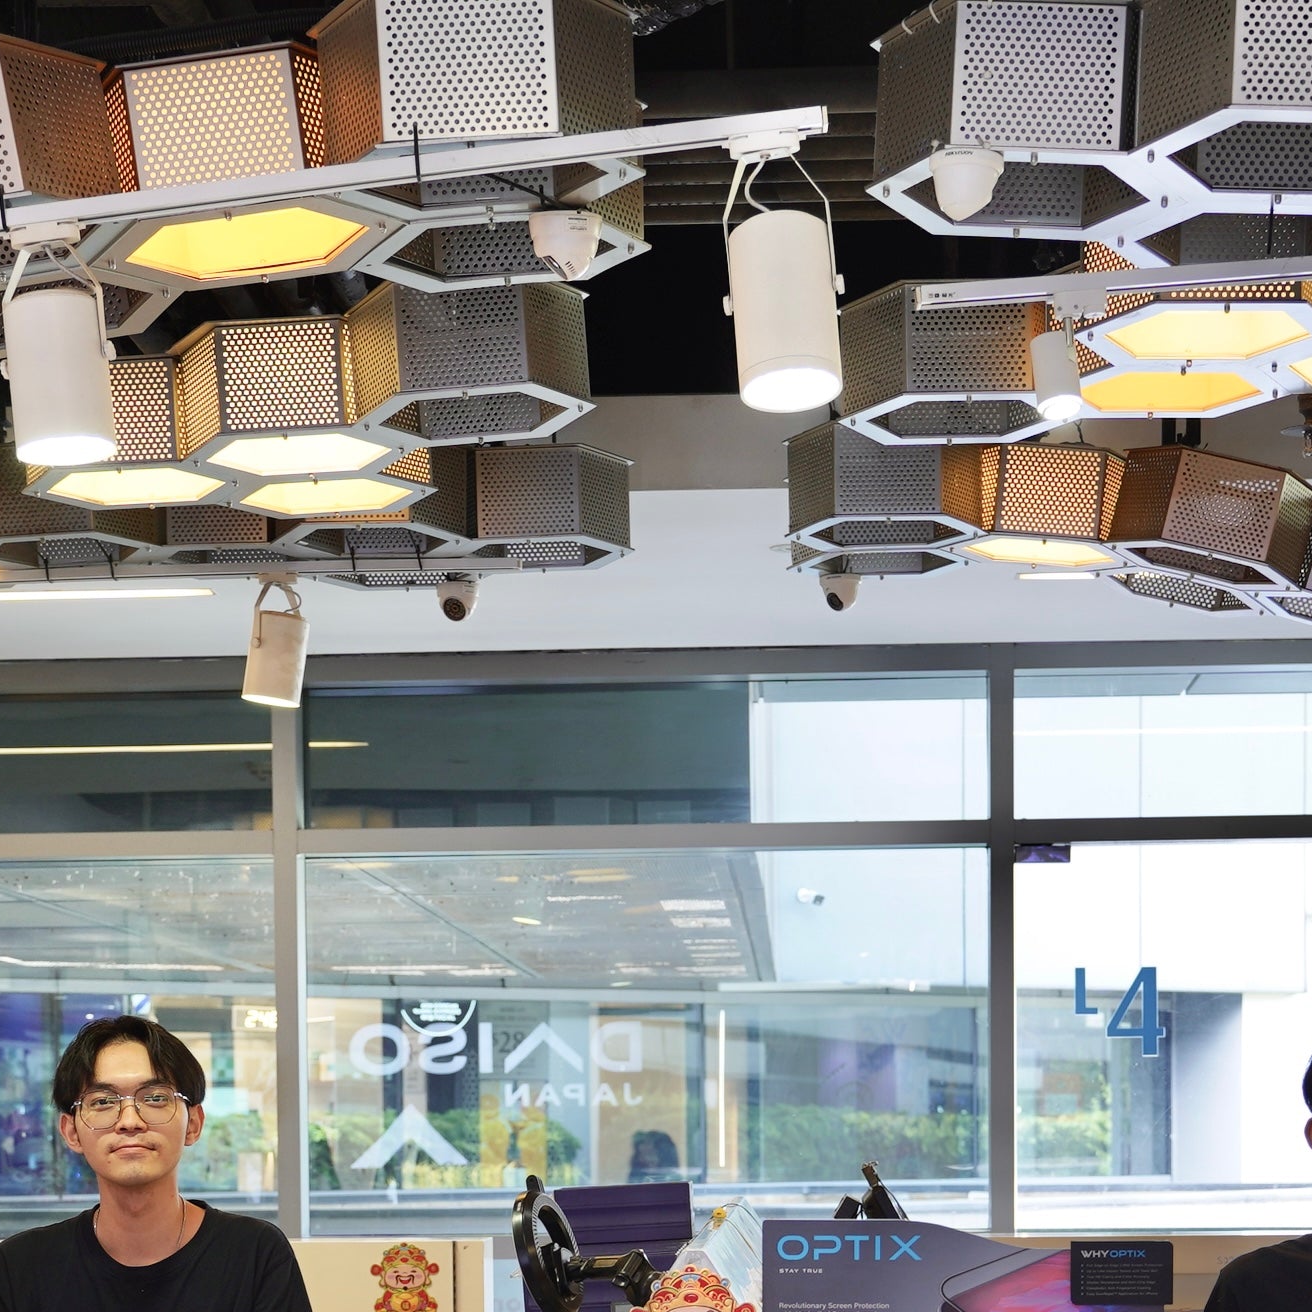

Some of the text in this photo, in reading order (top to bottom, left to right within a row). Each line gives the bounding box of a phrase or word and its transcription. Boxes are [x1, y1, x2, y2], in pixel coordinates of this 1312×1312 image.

[776, 1234, 923, 1261] OPTIX
[778, 1302, 890, 1311] Revolutionary Screen Protection
